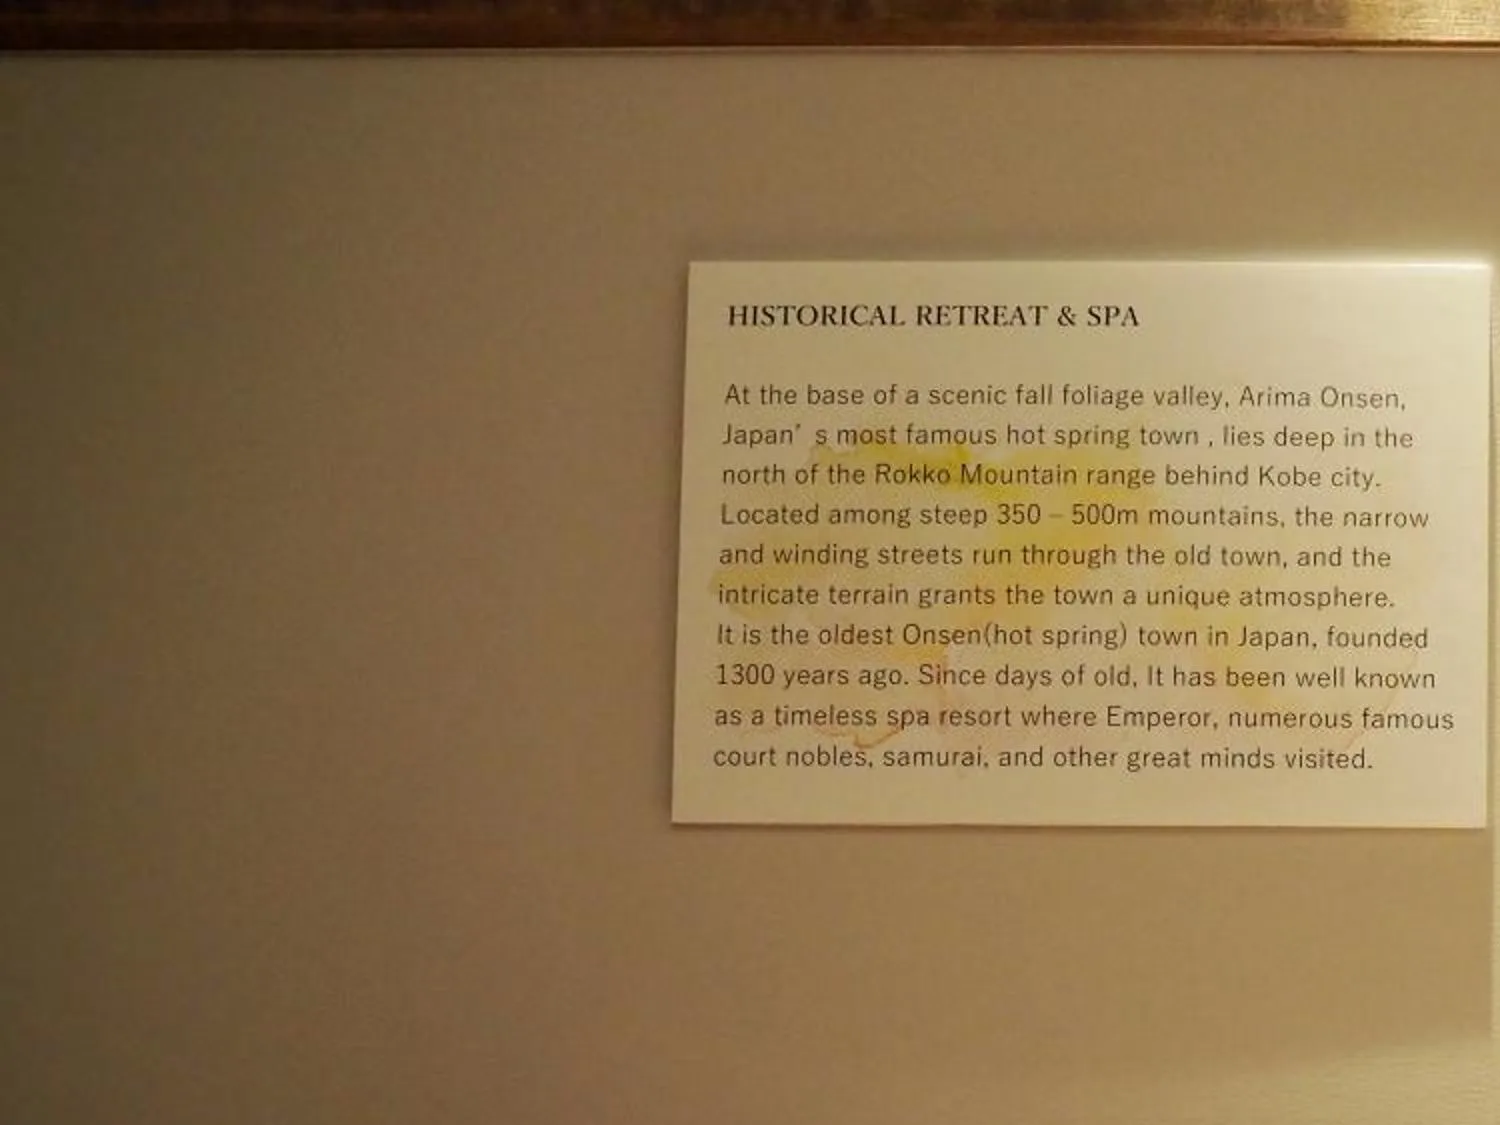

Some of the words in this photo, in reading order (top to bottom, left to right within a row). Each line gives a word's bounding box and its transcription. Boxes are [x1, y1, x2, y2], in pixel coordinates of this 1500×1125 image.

[728, 303, 907, 328] HISTORICAL
[915, 304, 1050, 328] RETREAT
[1086, 304, 1141, 328] SPA
[723, 383, 751, 406] At
[759, 383, 798, 406] the
[806, 383, 865, 406] base
[873, 383, 898, 406] of
[904, 388, 920, 406] a
[927, 384, 1008, 406] scenic
[1015, 383, 1053, 406] fall
[1062, 383, 1145, 412] foliage
[1153, 384, 1230, 411] valley,
[1238, 384, 1312, 408] Arima
[1319, 385, 1406, 412] Onsen,
[720, 502, 820, 526] Located
[827, 506, 912, 530] among
[919, 503, 988, 529] steep
[996, 502, 1042, 526] 350
[1071, 502, 1139, 526] 500m
[1148, 504, 1286, 529] mountains,
[1294, 504, 1334, 528] the
[1342, 511, 1430, 530] narrow
[718, 582, 820, 606] intricate
[828, 582, 909, 606] terrain
[917, 583, 996, 610] grants
[1005, 583, 1046, 606] the
[1053, 584, 1114, 606] town
[1122, 589, 1137, 607] a
[1146, 584, 1231, 611] unique
[1238, 585, 1396, 612] atmosphere.
[714, 708, 743, 727] as
[751, 708, 765, 727] a
[774, 703, 878, 728] timeless
[886, 708, 931, 731] spa
[938, 705, 1013, 728] resort
[1020, 703, 1098, 728] where
[1106, 704, 1219, 733] Emperor,
[1228, 710, 1353, 730] numerous
[1361, 706, 1455, 731] famous
[712, 746, 777, 768] court
[785, 741, 874, 769] nobles,
[882, 744, 990, 769] samurai,
[997, 744, 1044, 768] and
[1052, 744, 1119, 769] other
[1126, 747, 1192, 774] great
[1200, 745, 1276, 770] minds
[1284, 746, 1374, 770] visited.
